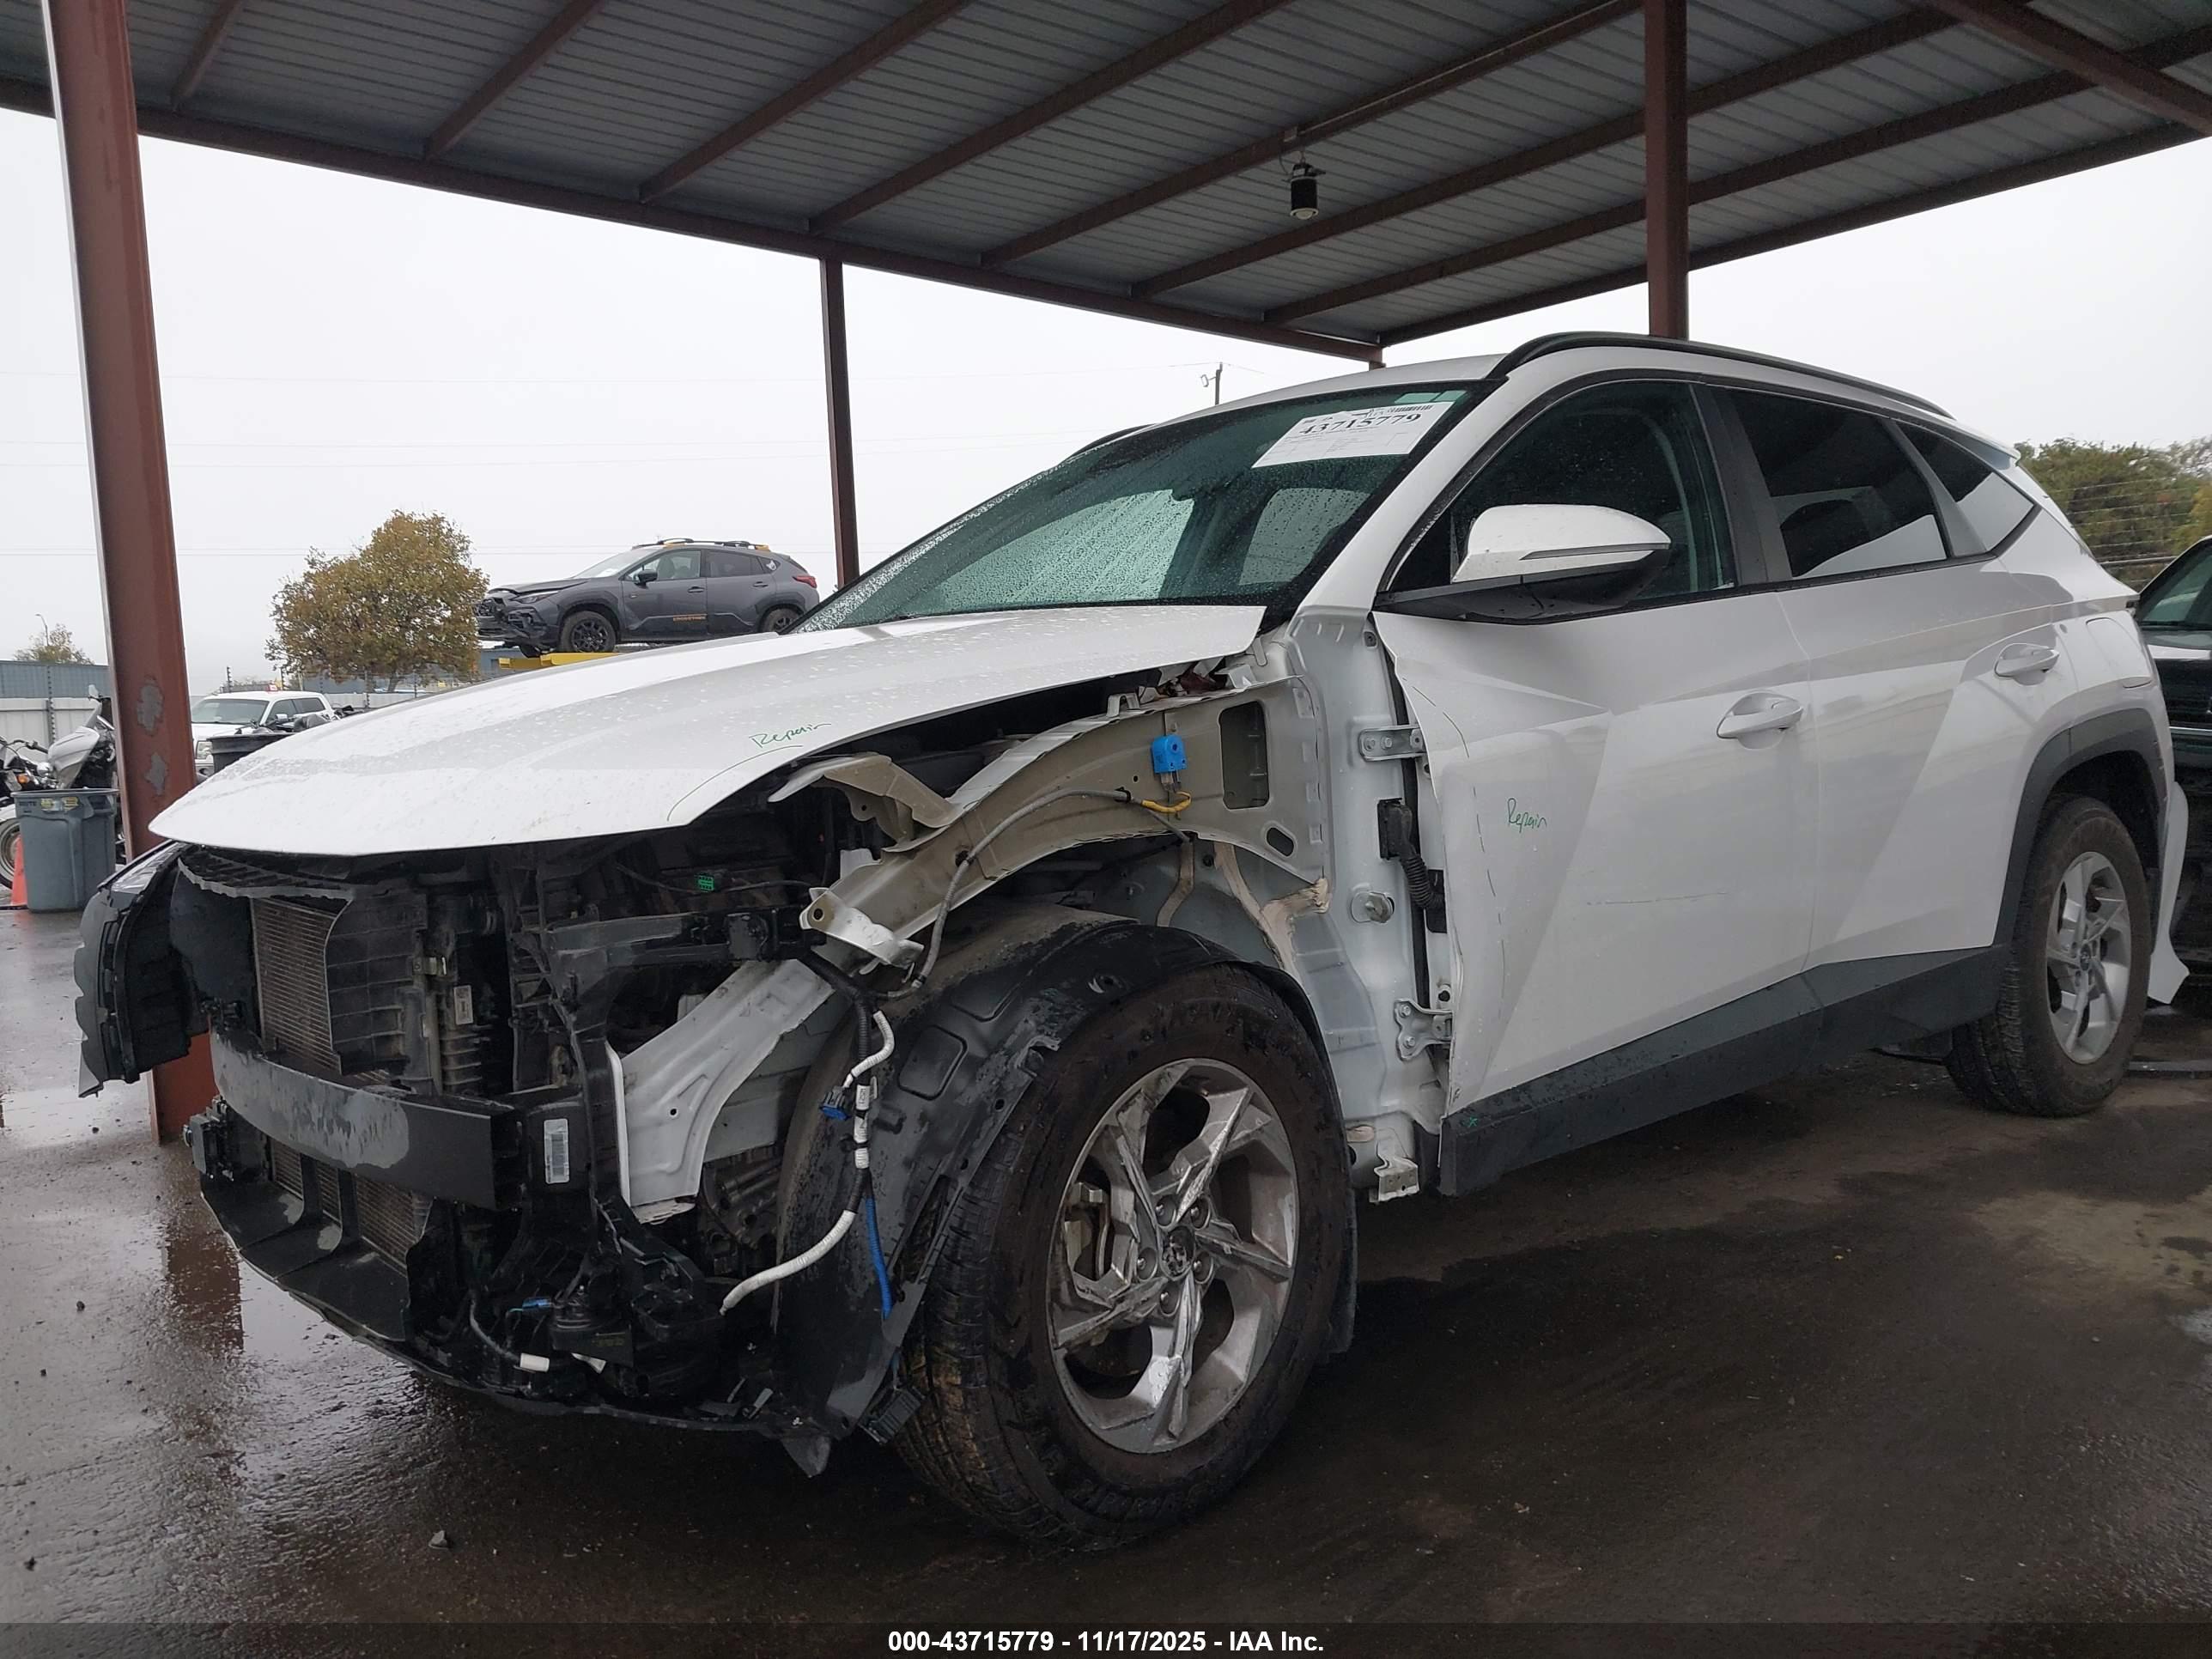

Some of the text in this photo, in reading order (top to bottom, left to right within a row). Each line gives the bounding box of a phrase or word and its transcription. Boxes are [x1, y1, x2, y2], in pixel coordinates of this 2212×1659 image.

[1299, 413, 1422, 434] 43715779
[748, 723, 832, 749] Repair
[1507, 797, 1547, 834] Repair
